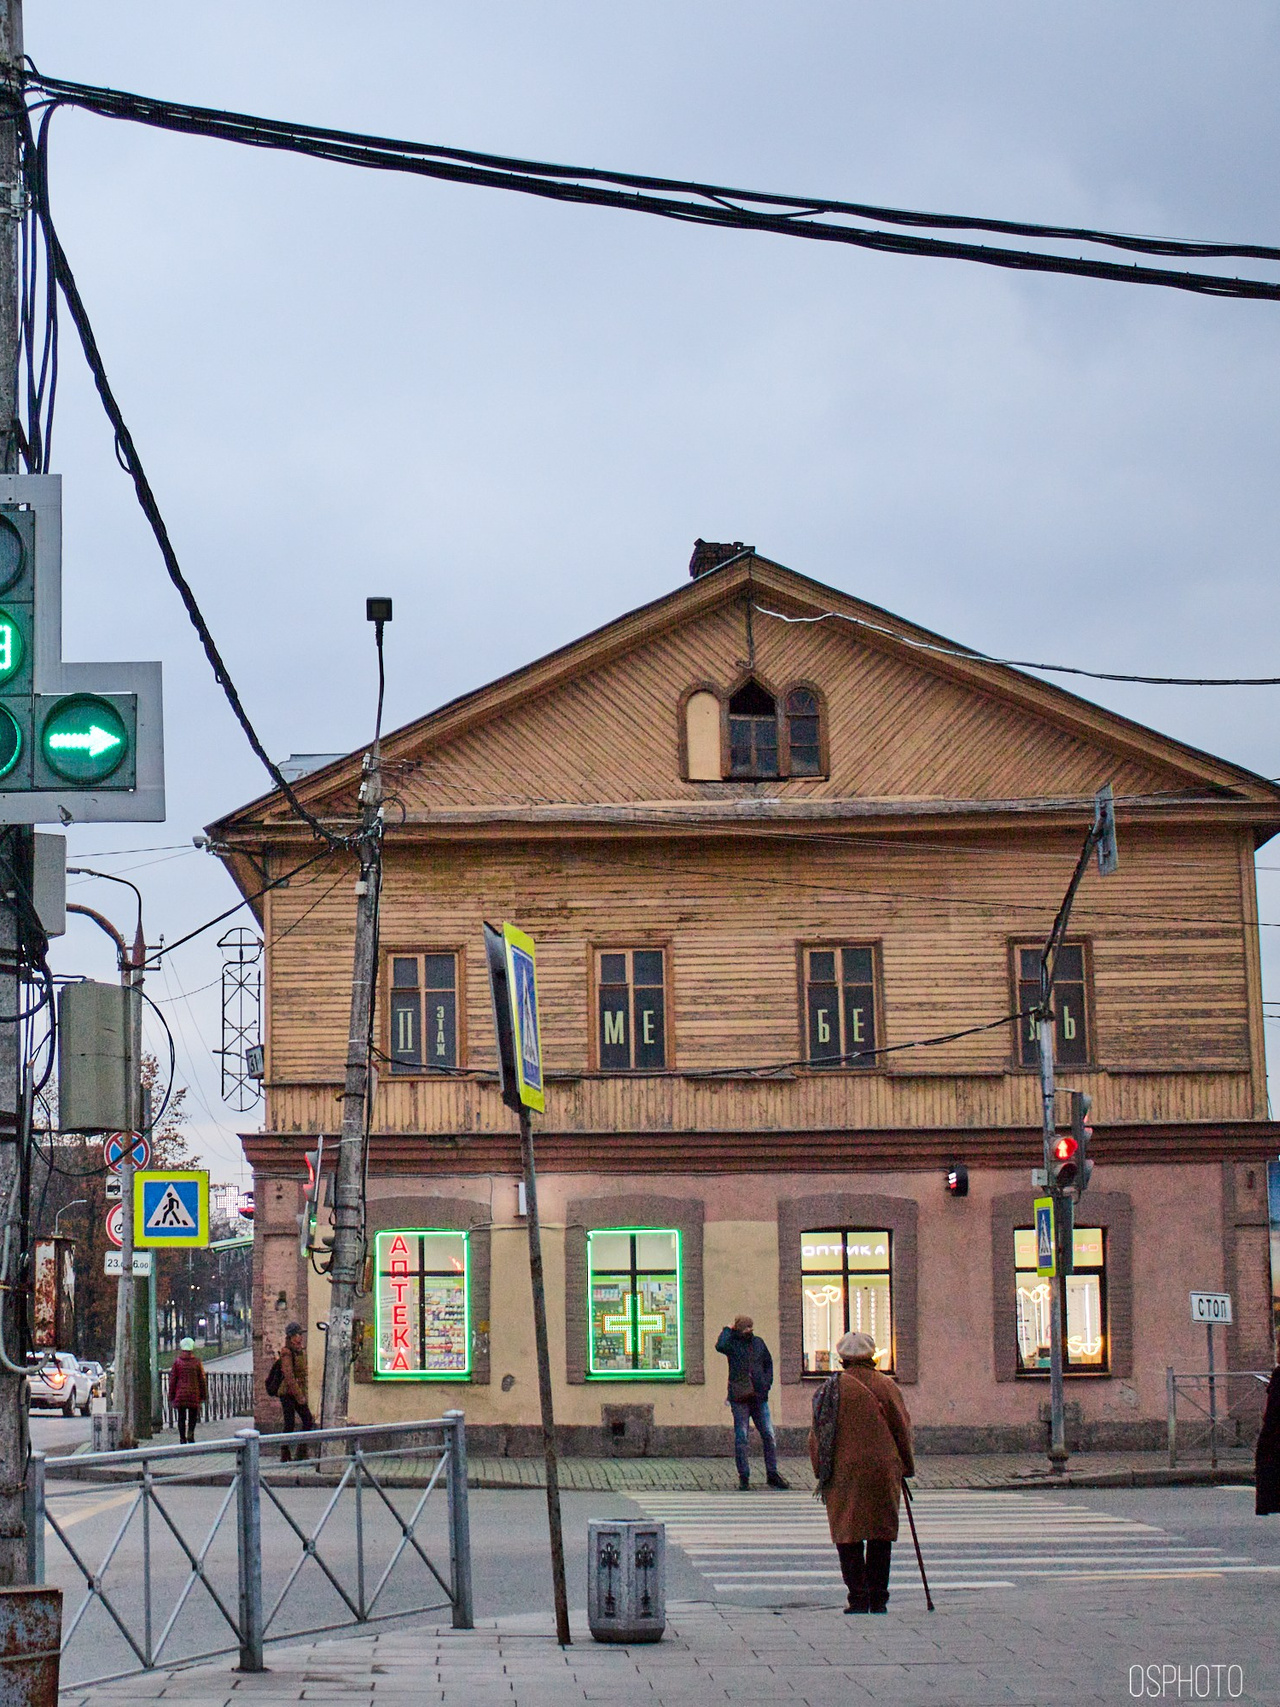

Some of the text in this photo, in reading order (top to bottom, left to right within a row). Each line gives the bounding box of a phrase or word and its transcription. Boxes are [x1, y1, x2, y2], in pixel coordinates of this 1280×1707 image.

[436, 1005, 446, 1056] ЭТАЖ
[801, 1244, 886, 1257] ОПТИКА
[388, 1234, 411, 1370] АПТЕКА
[1198, 1298, 1227, 1318] СТОП
